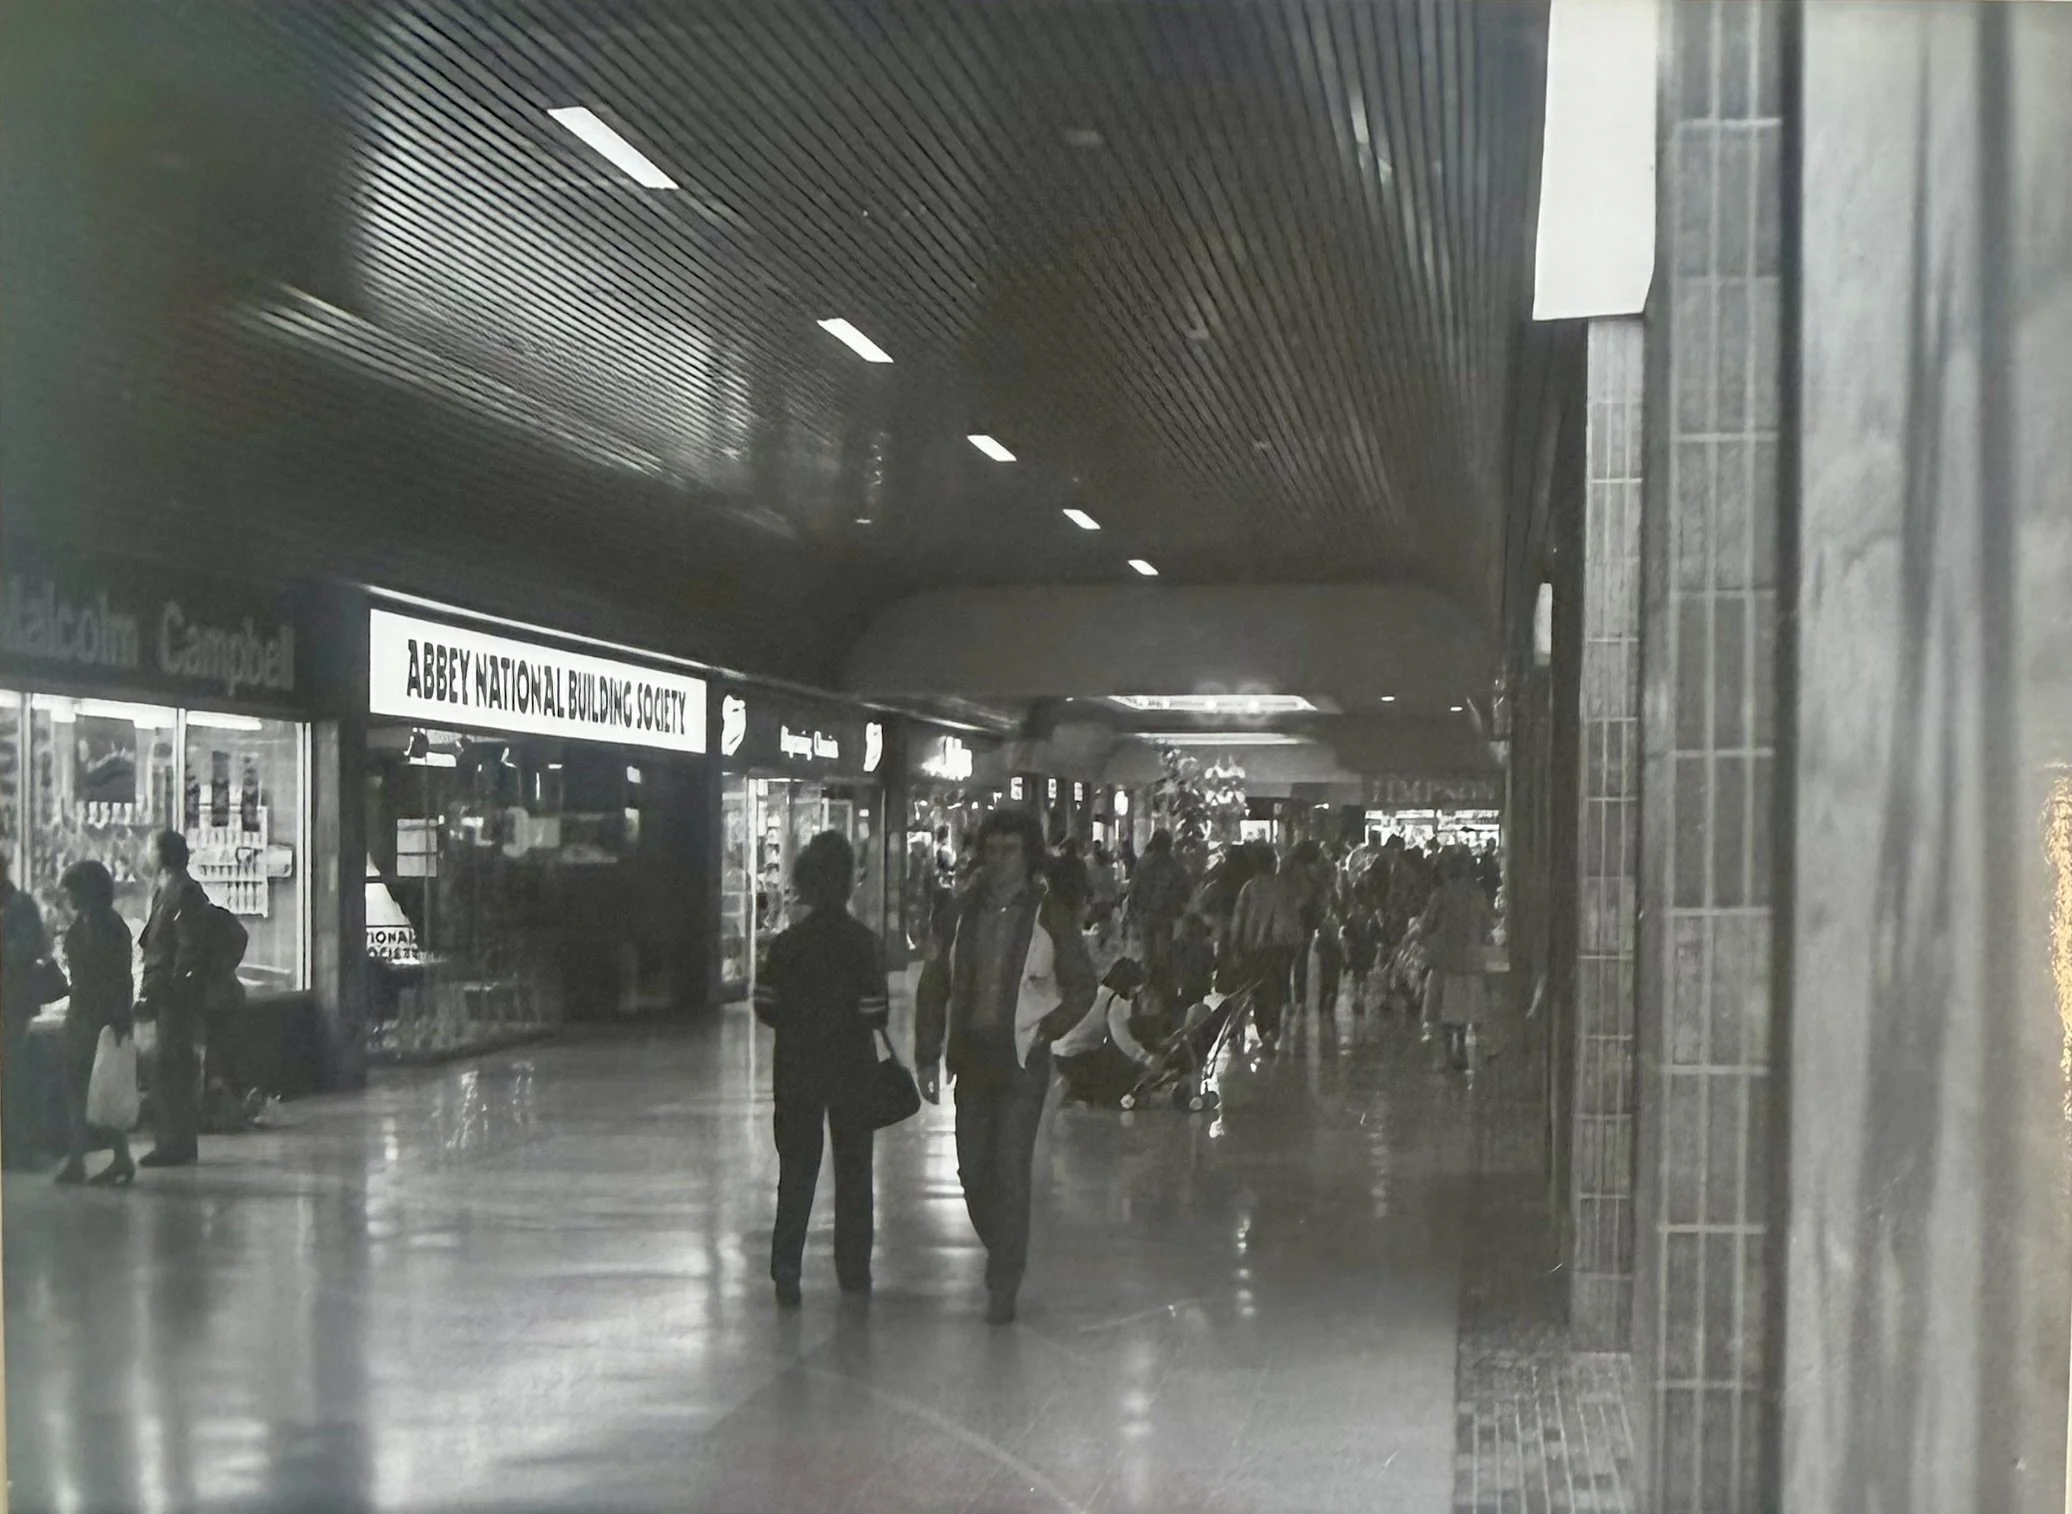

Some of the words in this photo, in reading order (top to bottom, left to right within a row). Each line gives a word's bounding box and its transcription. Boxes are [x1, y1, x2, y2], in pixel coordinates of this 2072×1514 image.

[159, 599, 295, 698] Campbell
[406, 638, 471, 706] ABBEY
[475, 652, 565, 719] NATIONAL
[568, 670, 633, 729] BUILDING
[637, 682, 687, 736] SOCIETY
